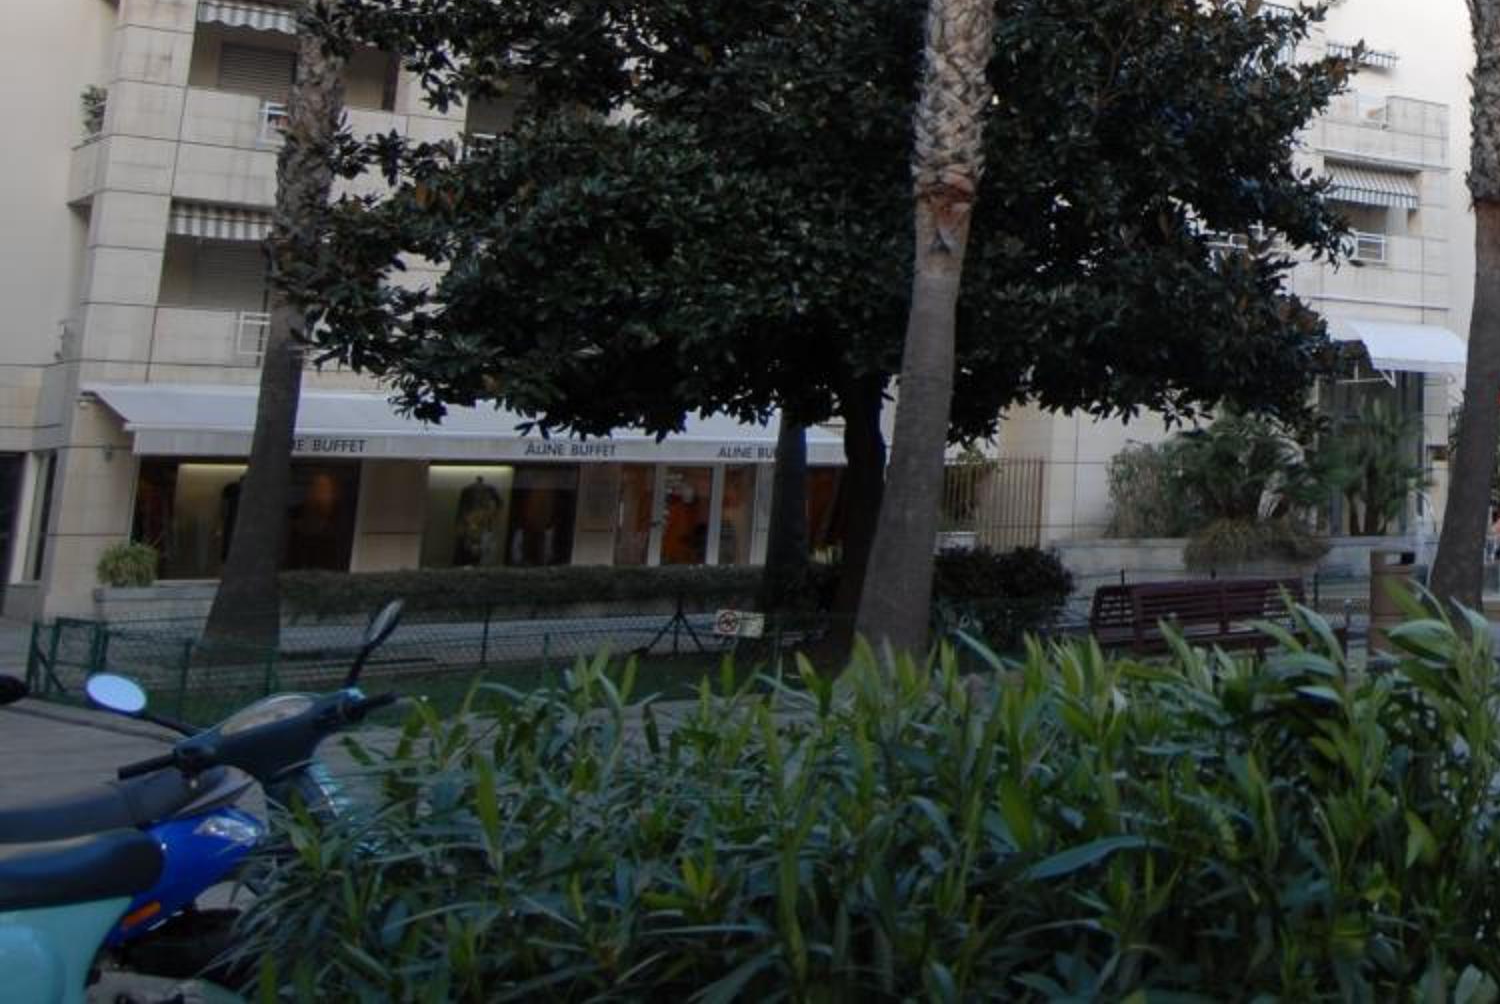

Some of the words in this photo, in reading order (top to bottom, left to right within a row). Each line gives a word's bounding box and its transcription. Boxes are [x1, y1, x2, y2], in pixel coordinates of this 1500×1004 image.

[312, 439, 367, 454] BUFFET
[525, 442, 564, 456] ALINE
[571, 443, 616, 456] BUFFET
